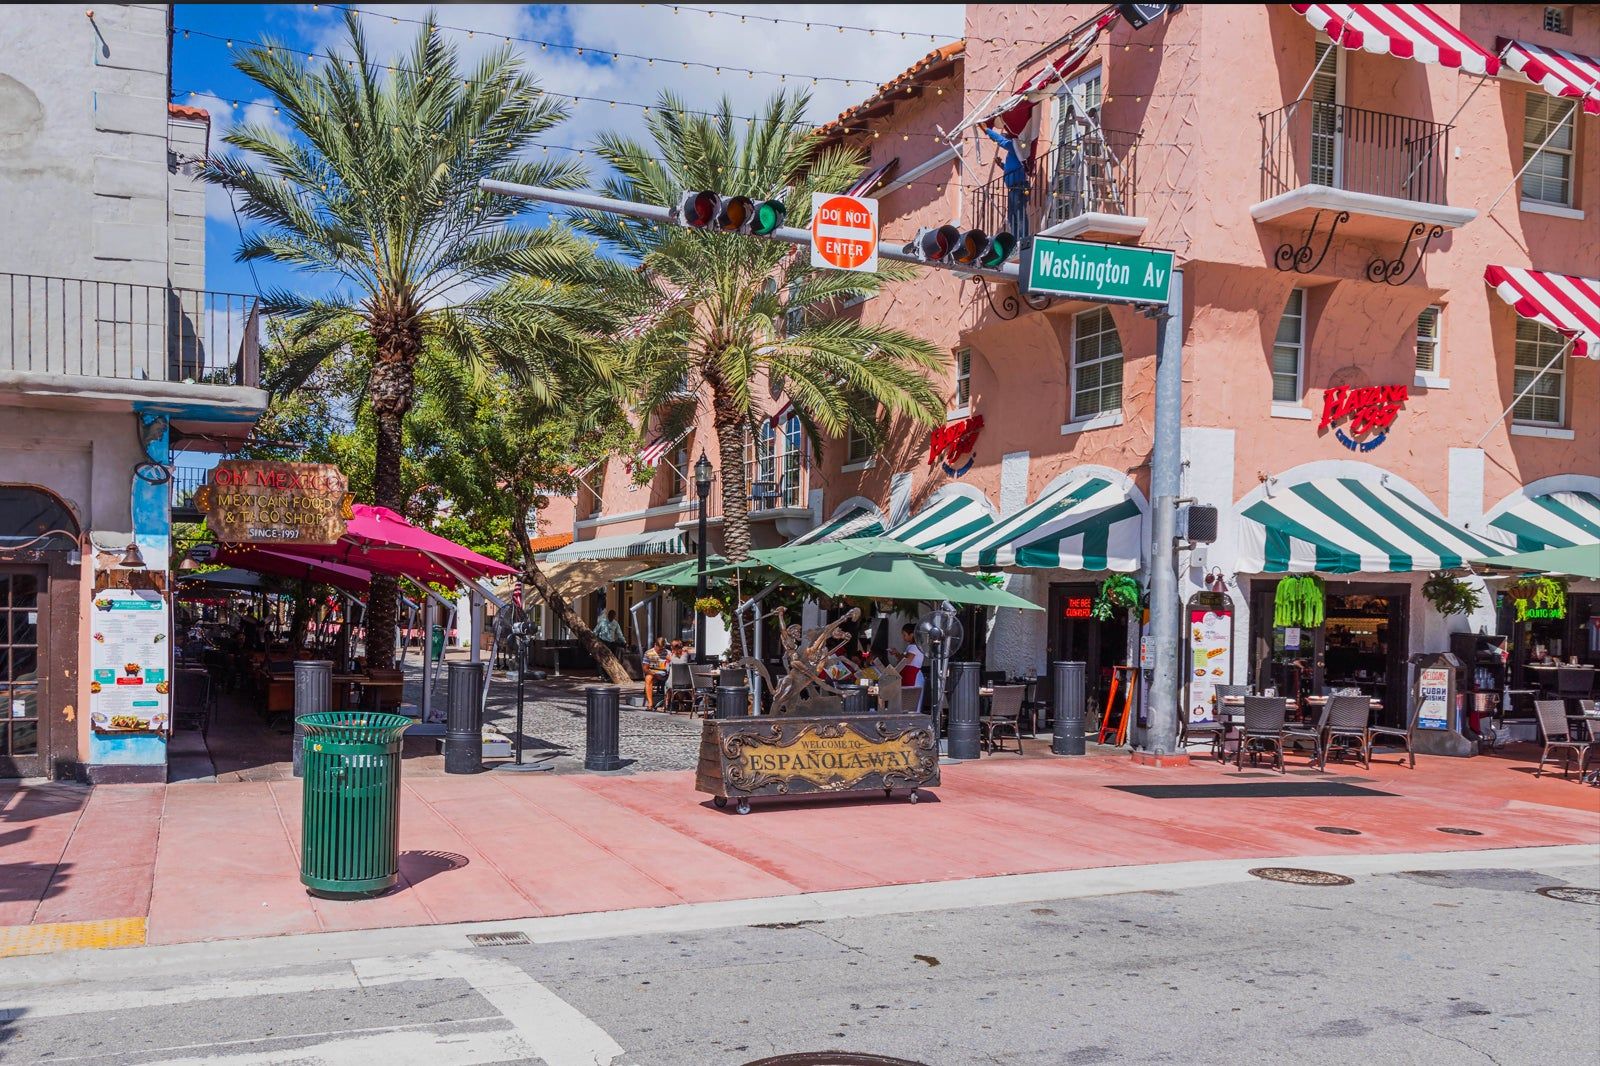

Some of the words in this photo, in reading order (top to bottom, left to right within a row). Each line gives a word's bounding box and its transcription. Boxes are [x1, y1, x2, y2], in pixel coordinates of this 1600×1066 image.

[822, 208, 838, 221] DO
[845, 211, 868, 225] NOT
[825, 241, 863, 256] ENTER
[1039, 250, 1130, 290] Washington
[1142, 261, 1165, 288] Av
[218, 494, 289, 509] MEXICAN
[293, 497, 333, 510] FOOD
[225, 511, 236, 524] &
[240, 510, 281, 525] TACO
[284, 512, 325, 525] SHOP
[248, 528, 300, 539] SINCE-1997
[1070, 598, 1080, 607] THE
[1421, 687, 1447, 695] CUBAN
[802, 740, 847, 749] WELCOME
[848, 741, 861, 749] TO
[867, 751, 913, 768] WAY
